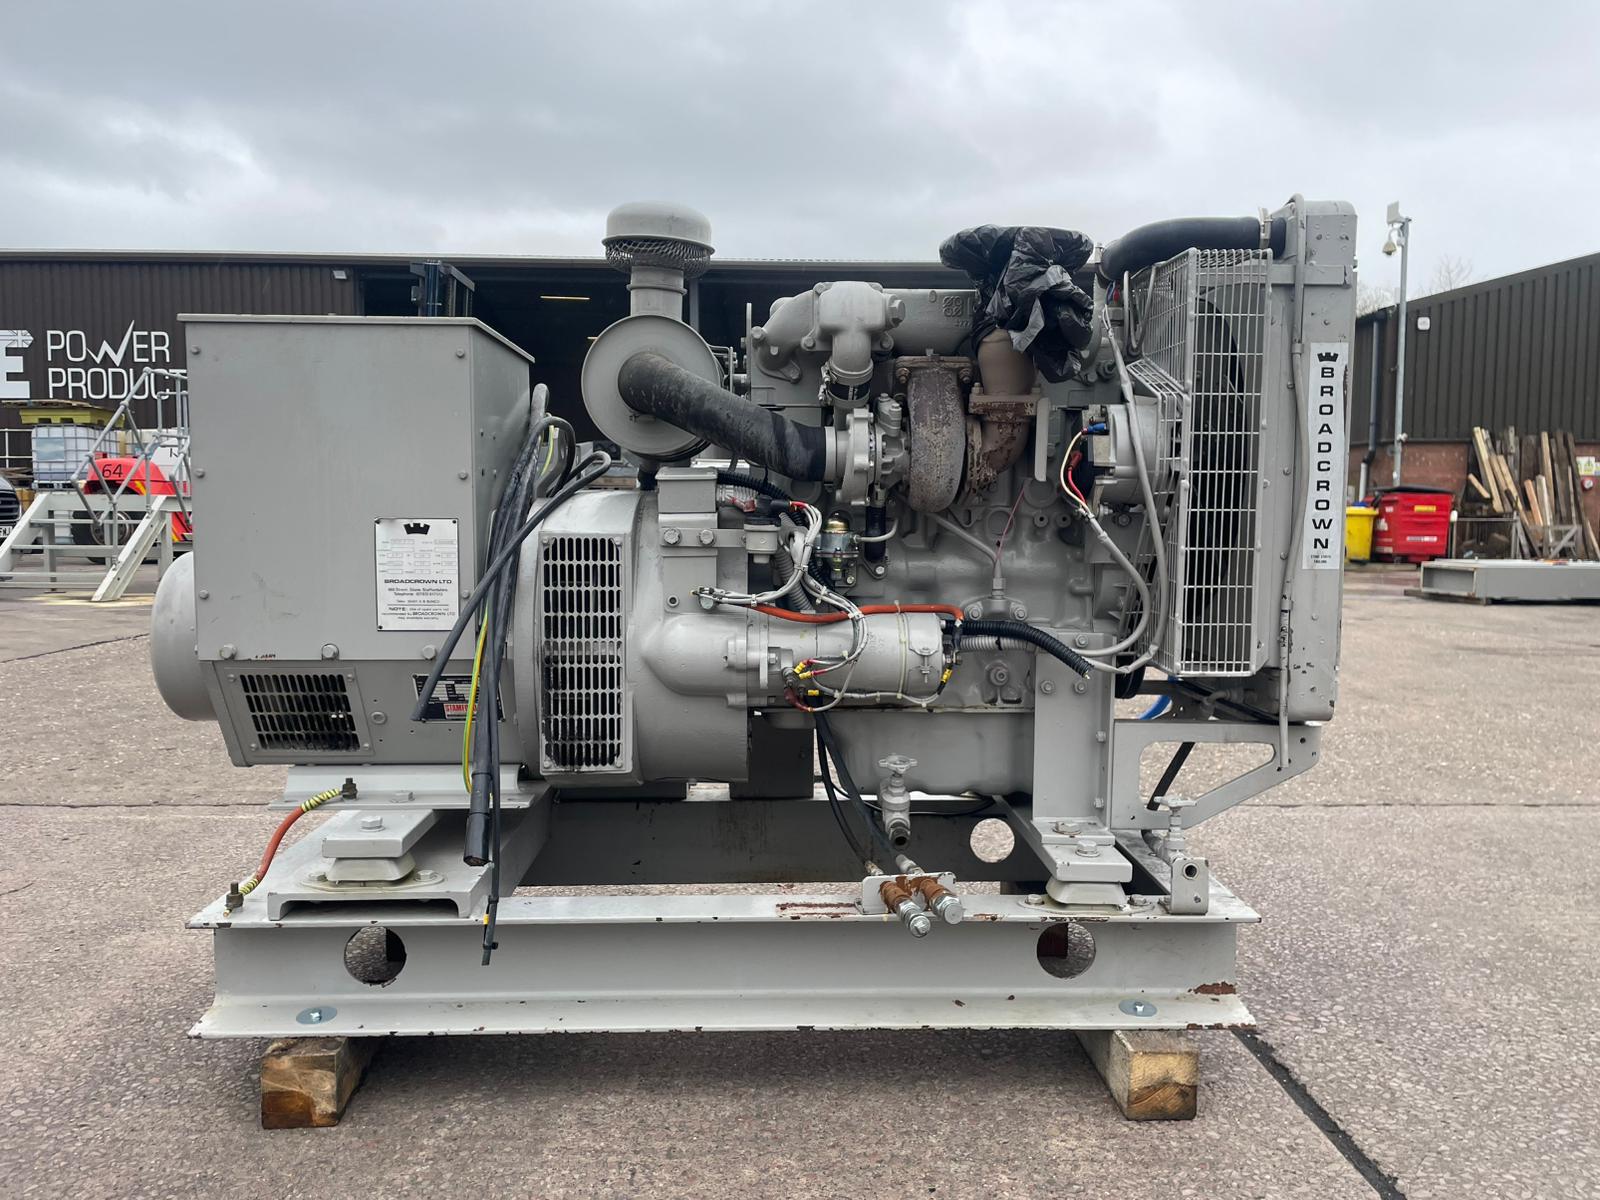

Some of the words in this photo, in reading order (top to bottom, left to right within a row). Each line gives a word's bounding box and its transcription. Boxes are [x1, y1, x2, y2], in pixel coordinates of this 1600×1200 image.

[46, 320, 170, 367] POWER
[102, 463, 123, 478] 64
[1312, 366, 1335, 549] BROADCROWN
